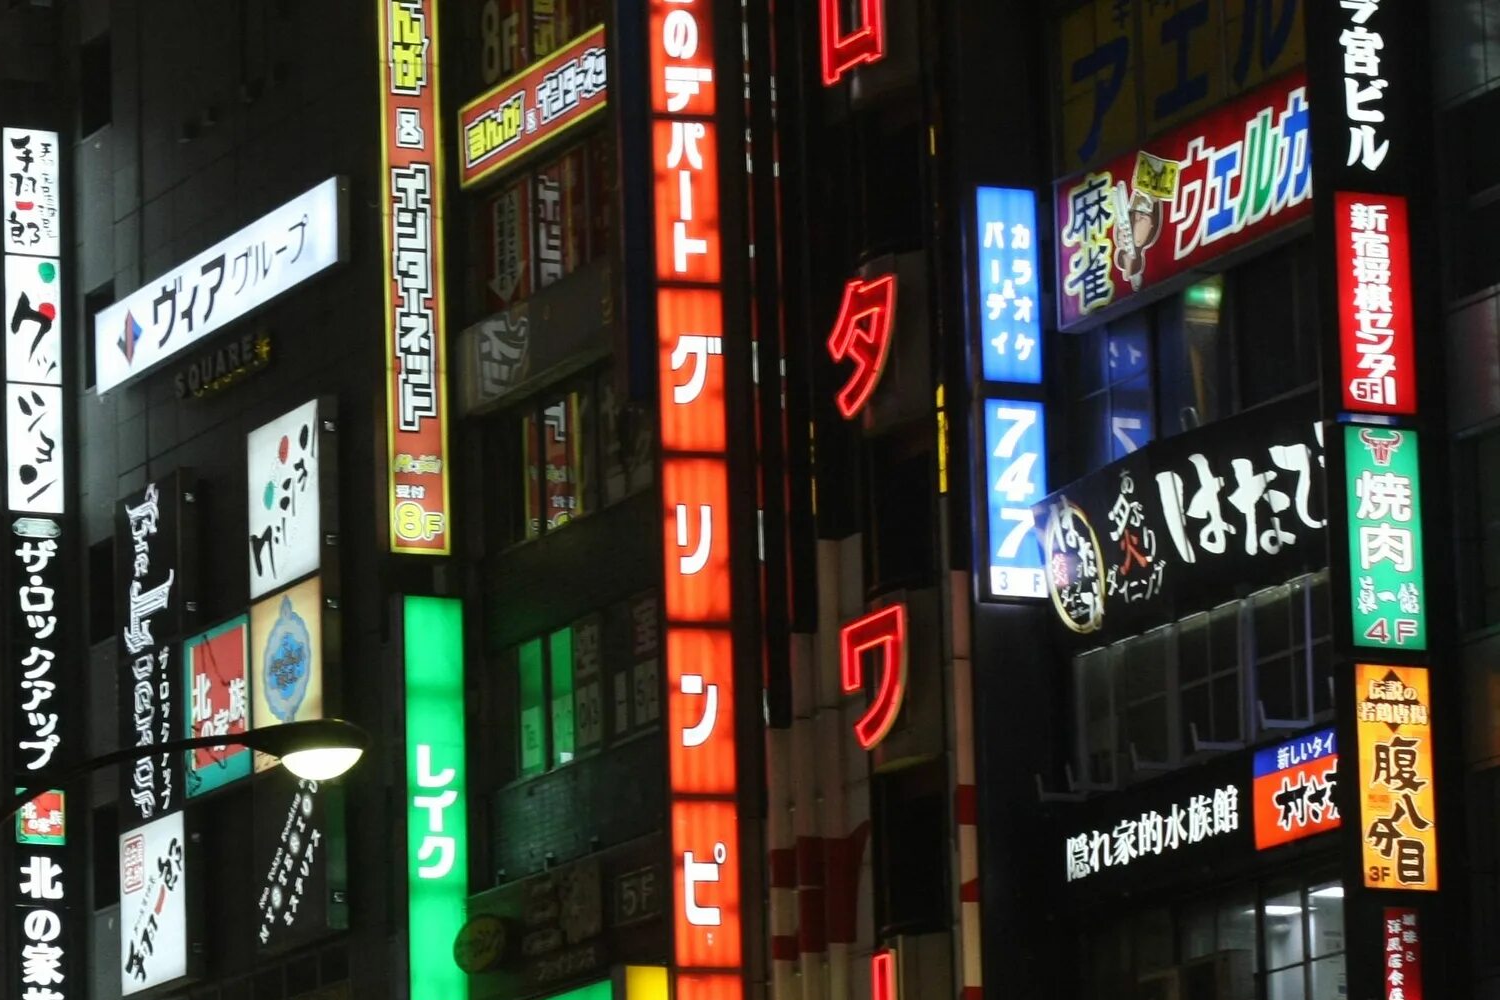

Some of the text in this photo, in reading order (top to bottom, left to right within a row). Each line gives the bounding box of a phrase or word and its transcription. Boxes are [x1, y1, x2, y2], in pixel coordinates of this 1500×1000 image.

[466, 92, 525, 167] まんが
[152, 213, 310, 350] ヴィアグループ
[392, 164, 437, 432] インターネット
[983, 221, 1009, 355] パーティ
[1011, 222, 1035, 361] カラオケ
[1063, 172, 1114, 315] 麻雀
[1350, 202, 1398, 406] 新宿将棋センター
[1356, 381, 1379, 399] 5F
[394, 502, 446, 542] 8F
[994, 407, 1037, 558] 747
[1356, 470, 1414, 573] 焼肉
[14, 539, 62, 771] ザ・ロックアップ
[1365, 618, 1419, 643] 4F
[1368, 680, 1417, 702] 伝説の
[414, 745, 459, 879] レイク
[1066, 784, 1239, 883] 隠れ家的水族館
[1366, 736, 1433, 886] 腹八分目
[1368, 866, 1391, 882] 3F
